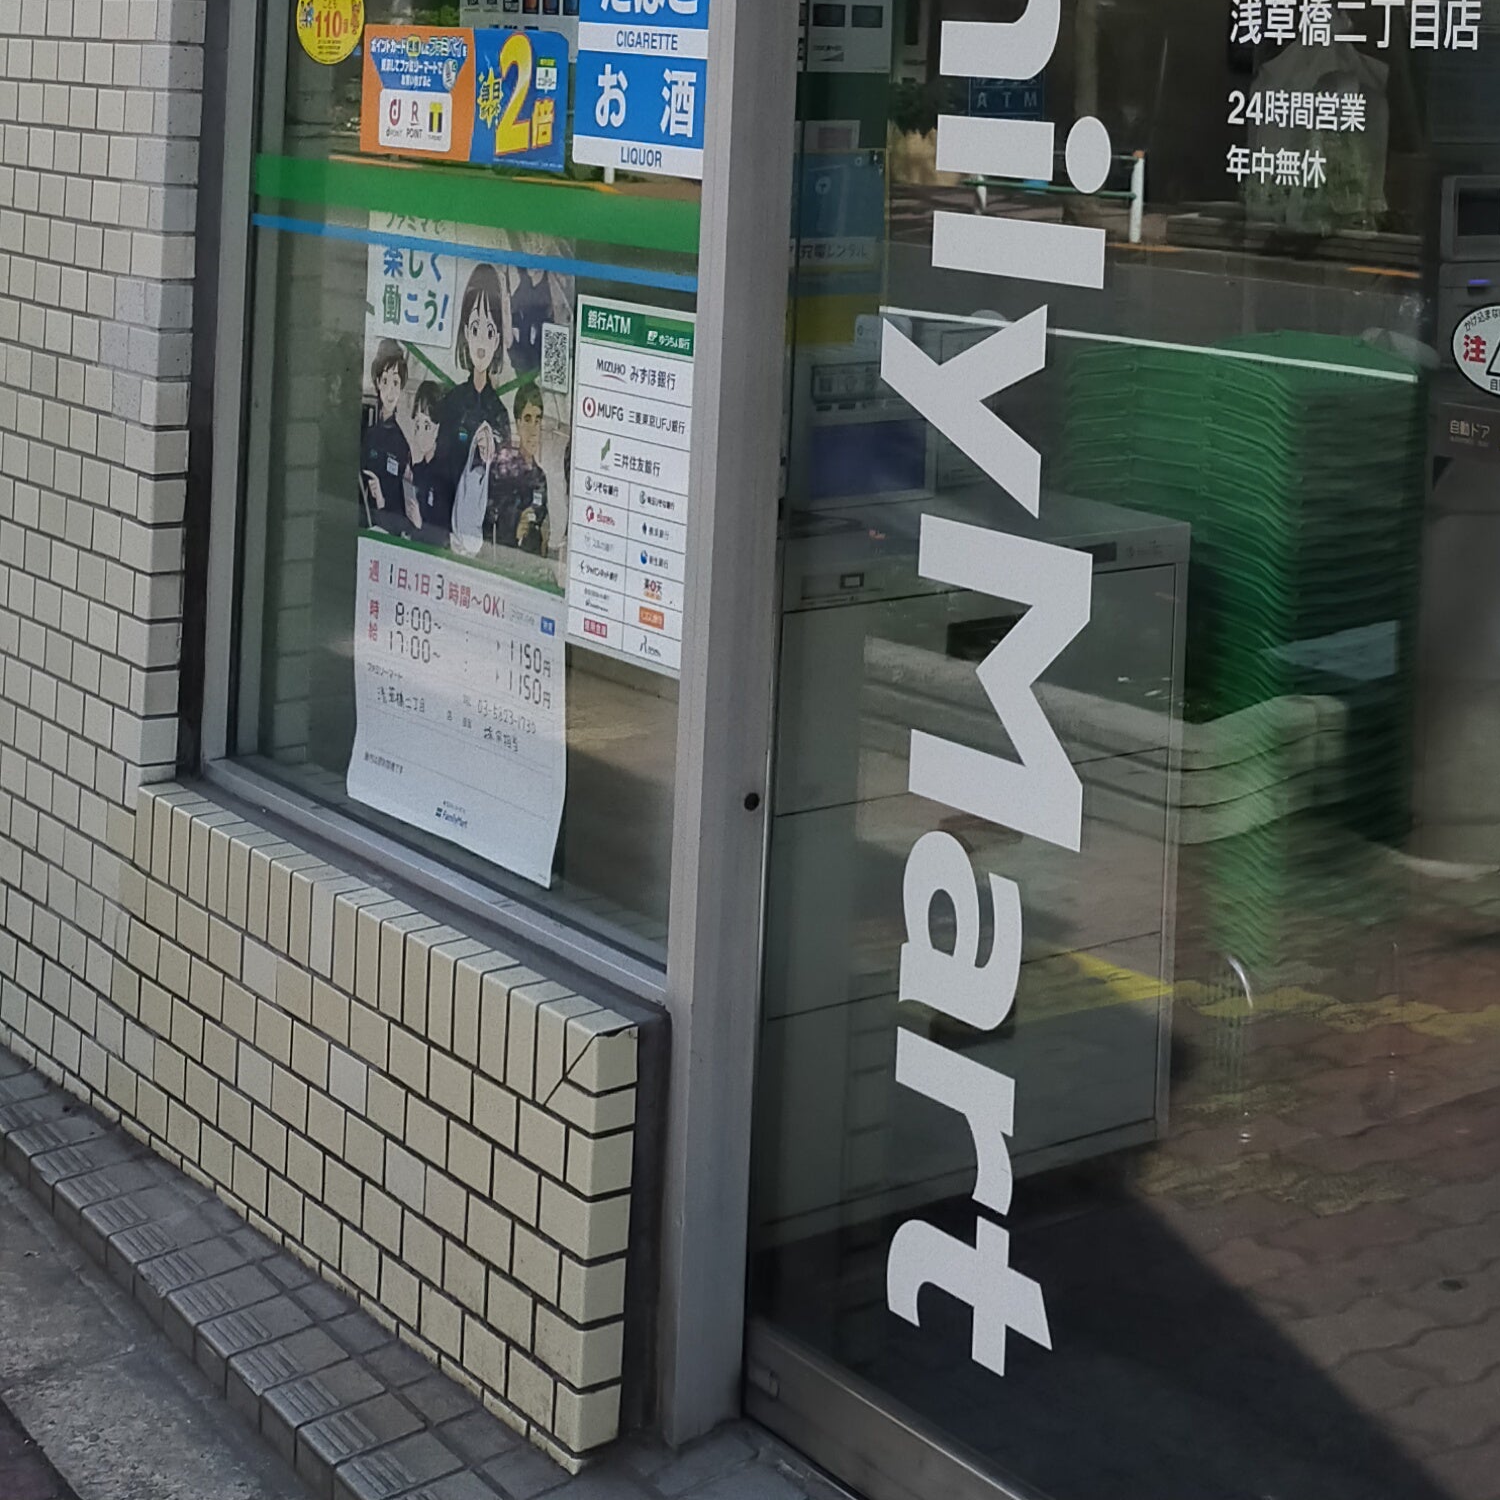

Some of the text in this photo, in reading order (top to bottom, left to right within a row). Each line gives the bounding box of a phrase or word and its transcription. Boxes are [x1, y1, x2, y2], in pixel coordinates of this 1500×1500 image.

[616, 30, 679, 51] CIGARETTE
[494, 31, 556, 156] 2 倍
[1227, 90, 1367, 132] 24時間営業
[620, 146, 662, 168] LIQUOR
[1226, 144, 1327, 188] 年中無休
[383, 246, 443, 282] 楽しく
[383, 283, 449, 332] 働こう!
[587, 309, 631, 335] 銀行ATM
[1463, 334, 1487, 363] 注
[596, 358, 677, 392] MIZUHO みずほ銀行
[597, 401, 624, 422] MUFG
[1450, 419, 1490, 438] 自動ドア
[613, 452, 661, 478] 三井住友銀行
